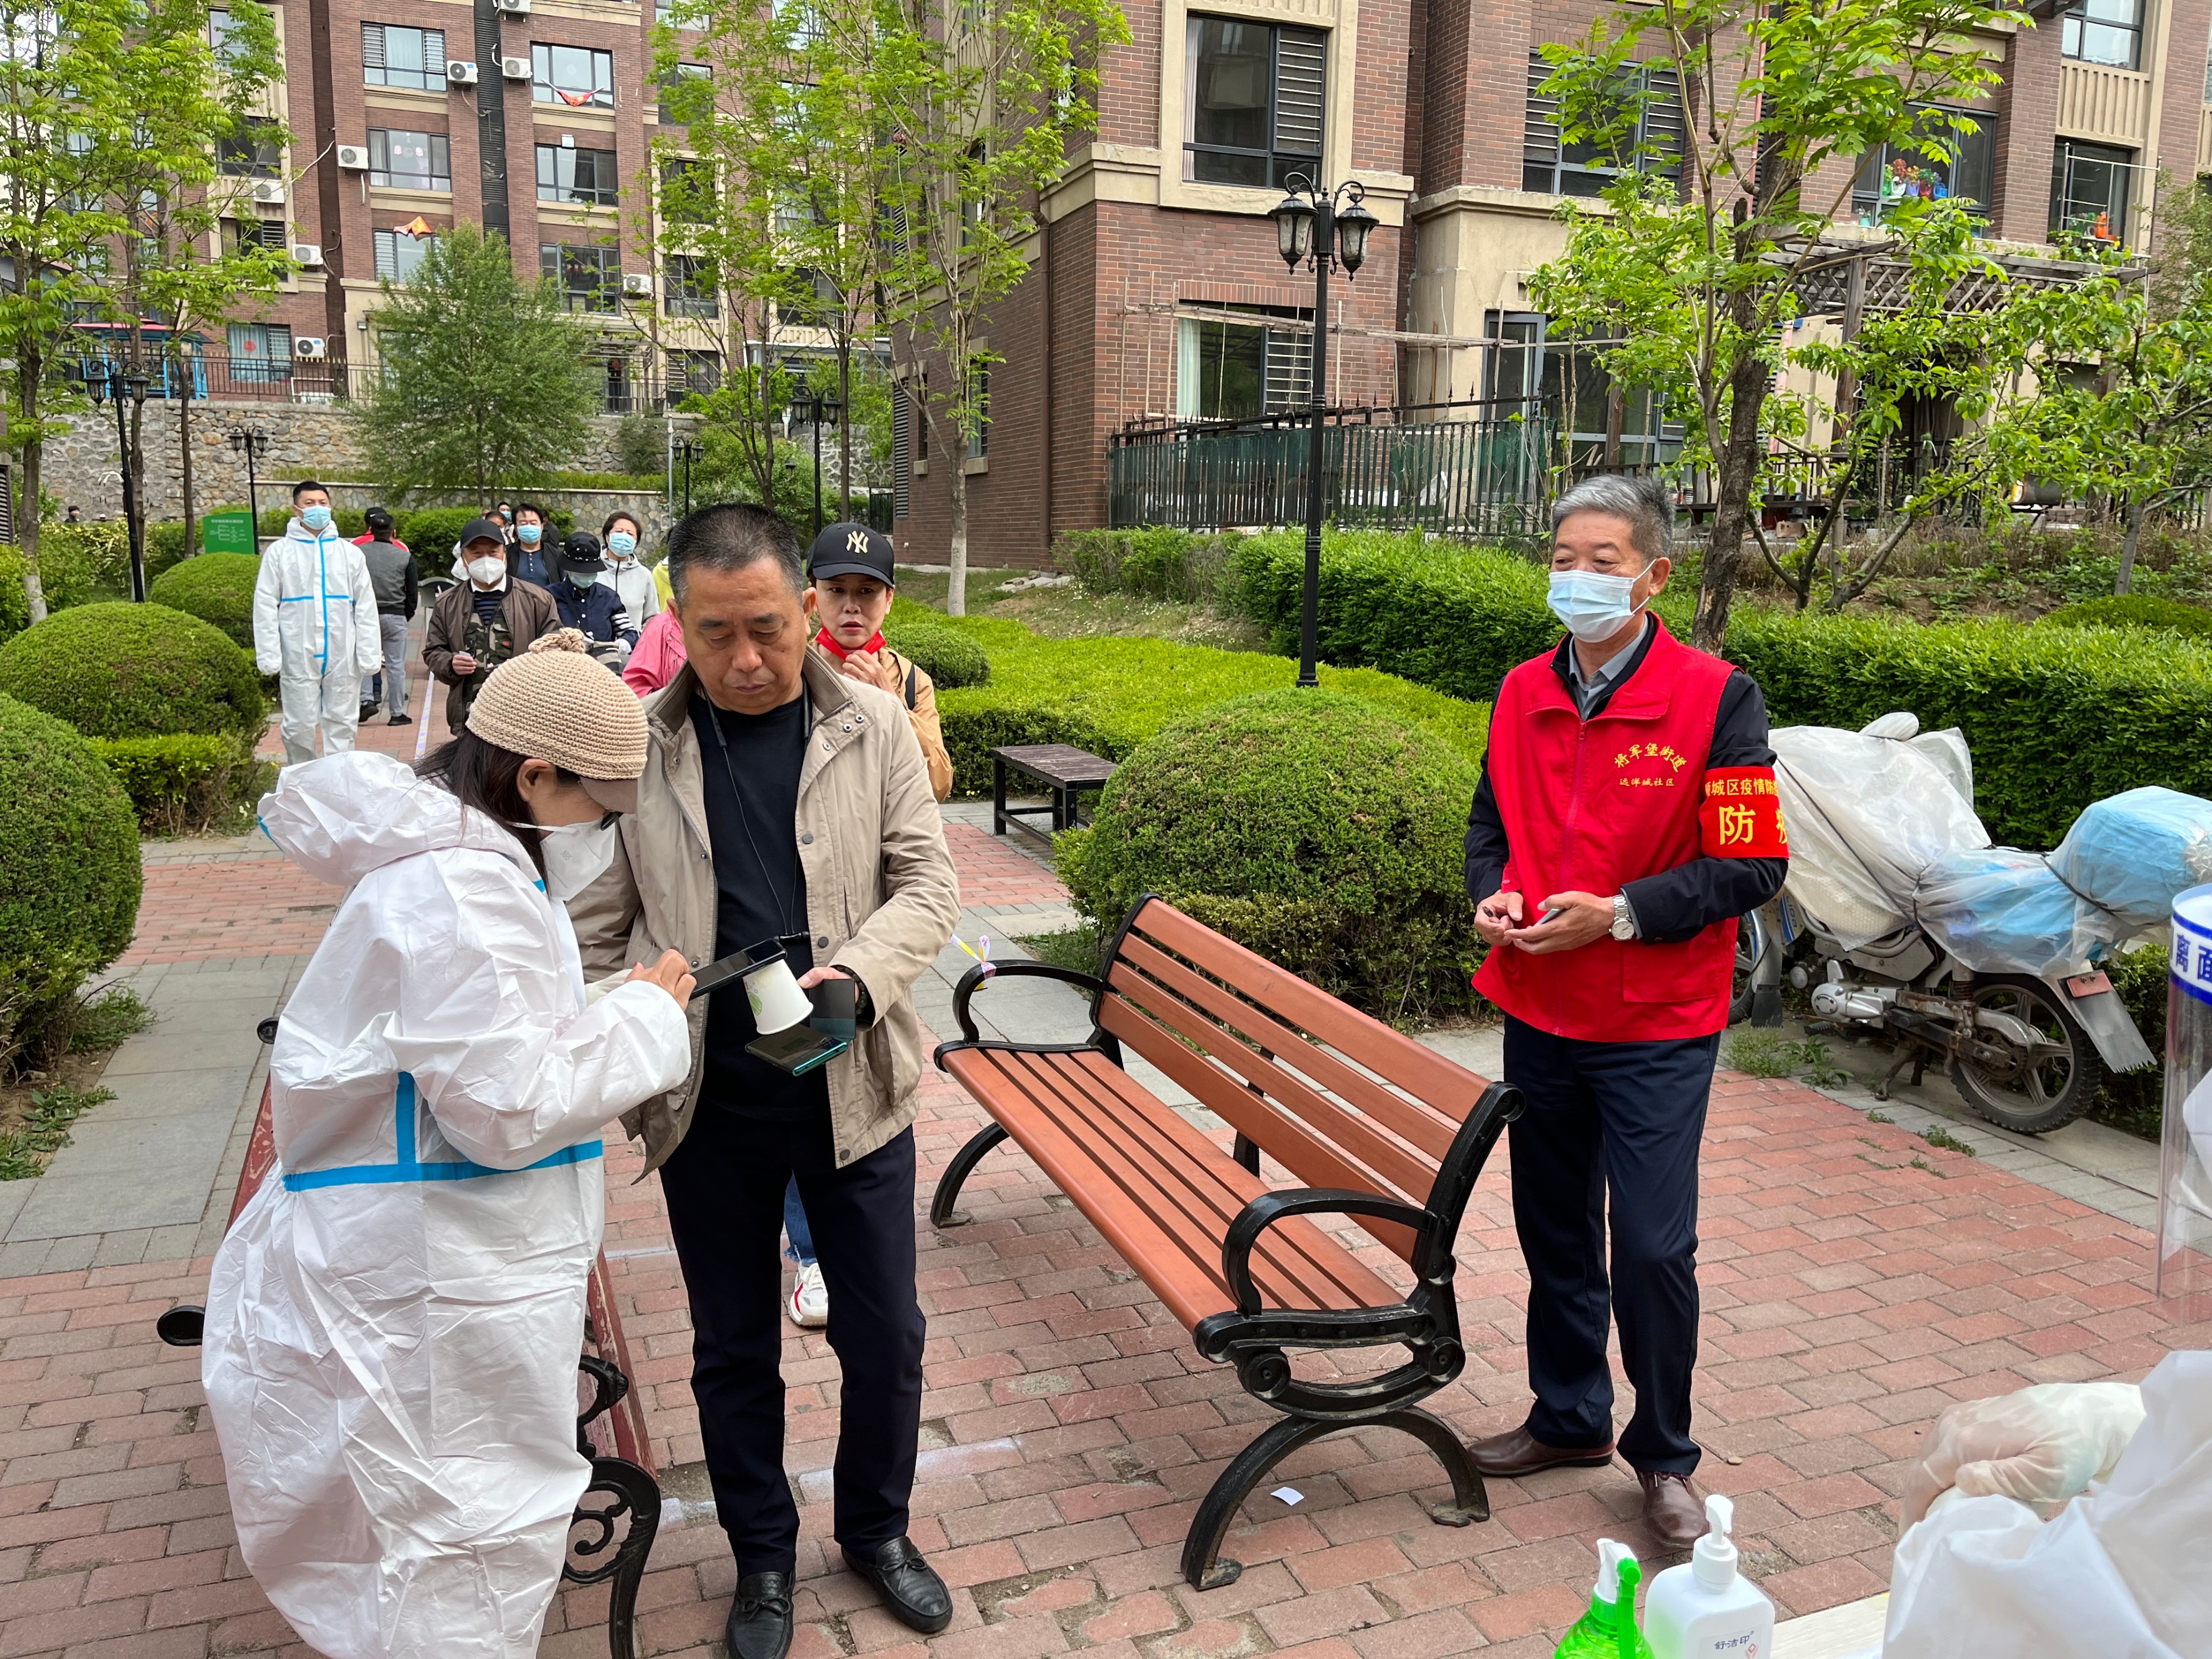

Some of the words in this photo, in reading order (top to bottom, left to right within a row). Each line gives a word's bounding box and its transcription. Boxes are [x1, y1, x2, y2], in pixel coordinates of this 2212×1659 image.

[846, 530, 869, 554] NY
[1614, 743, 1687, 773] 将军堡街道
[1619, 777, 1675, 787] 远洋城社区
[1714, 1635, 1749, 1650] 舒洁印
